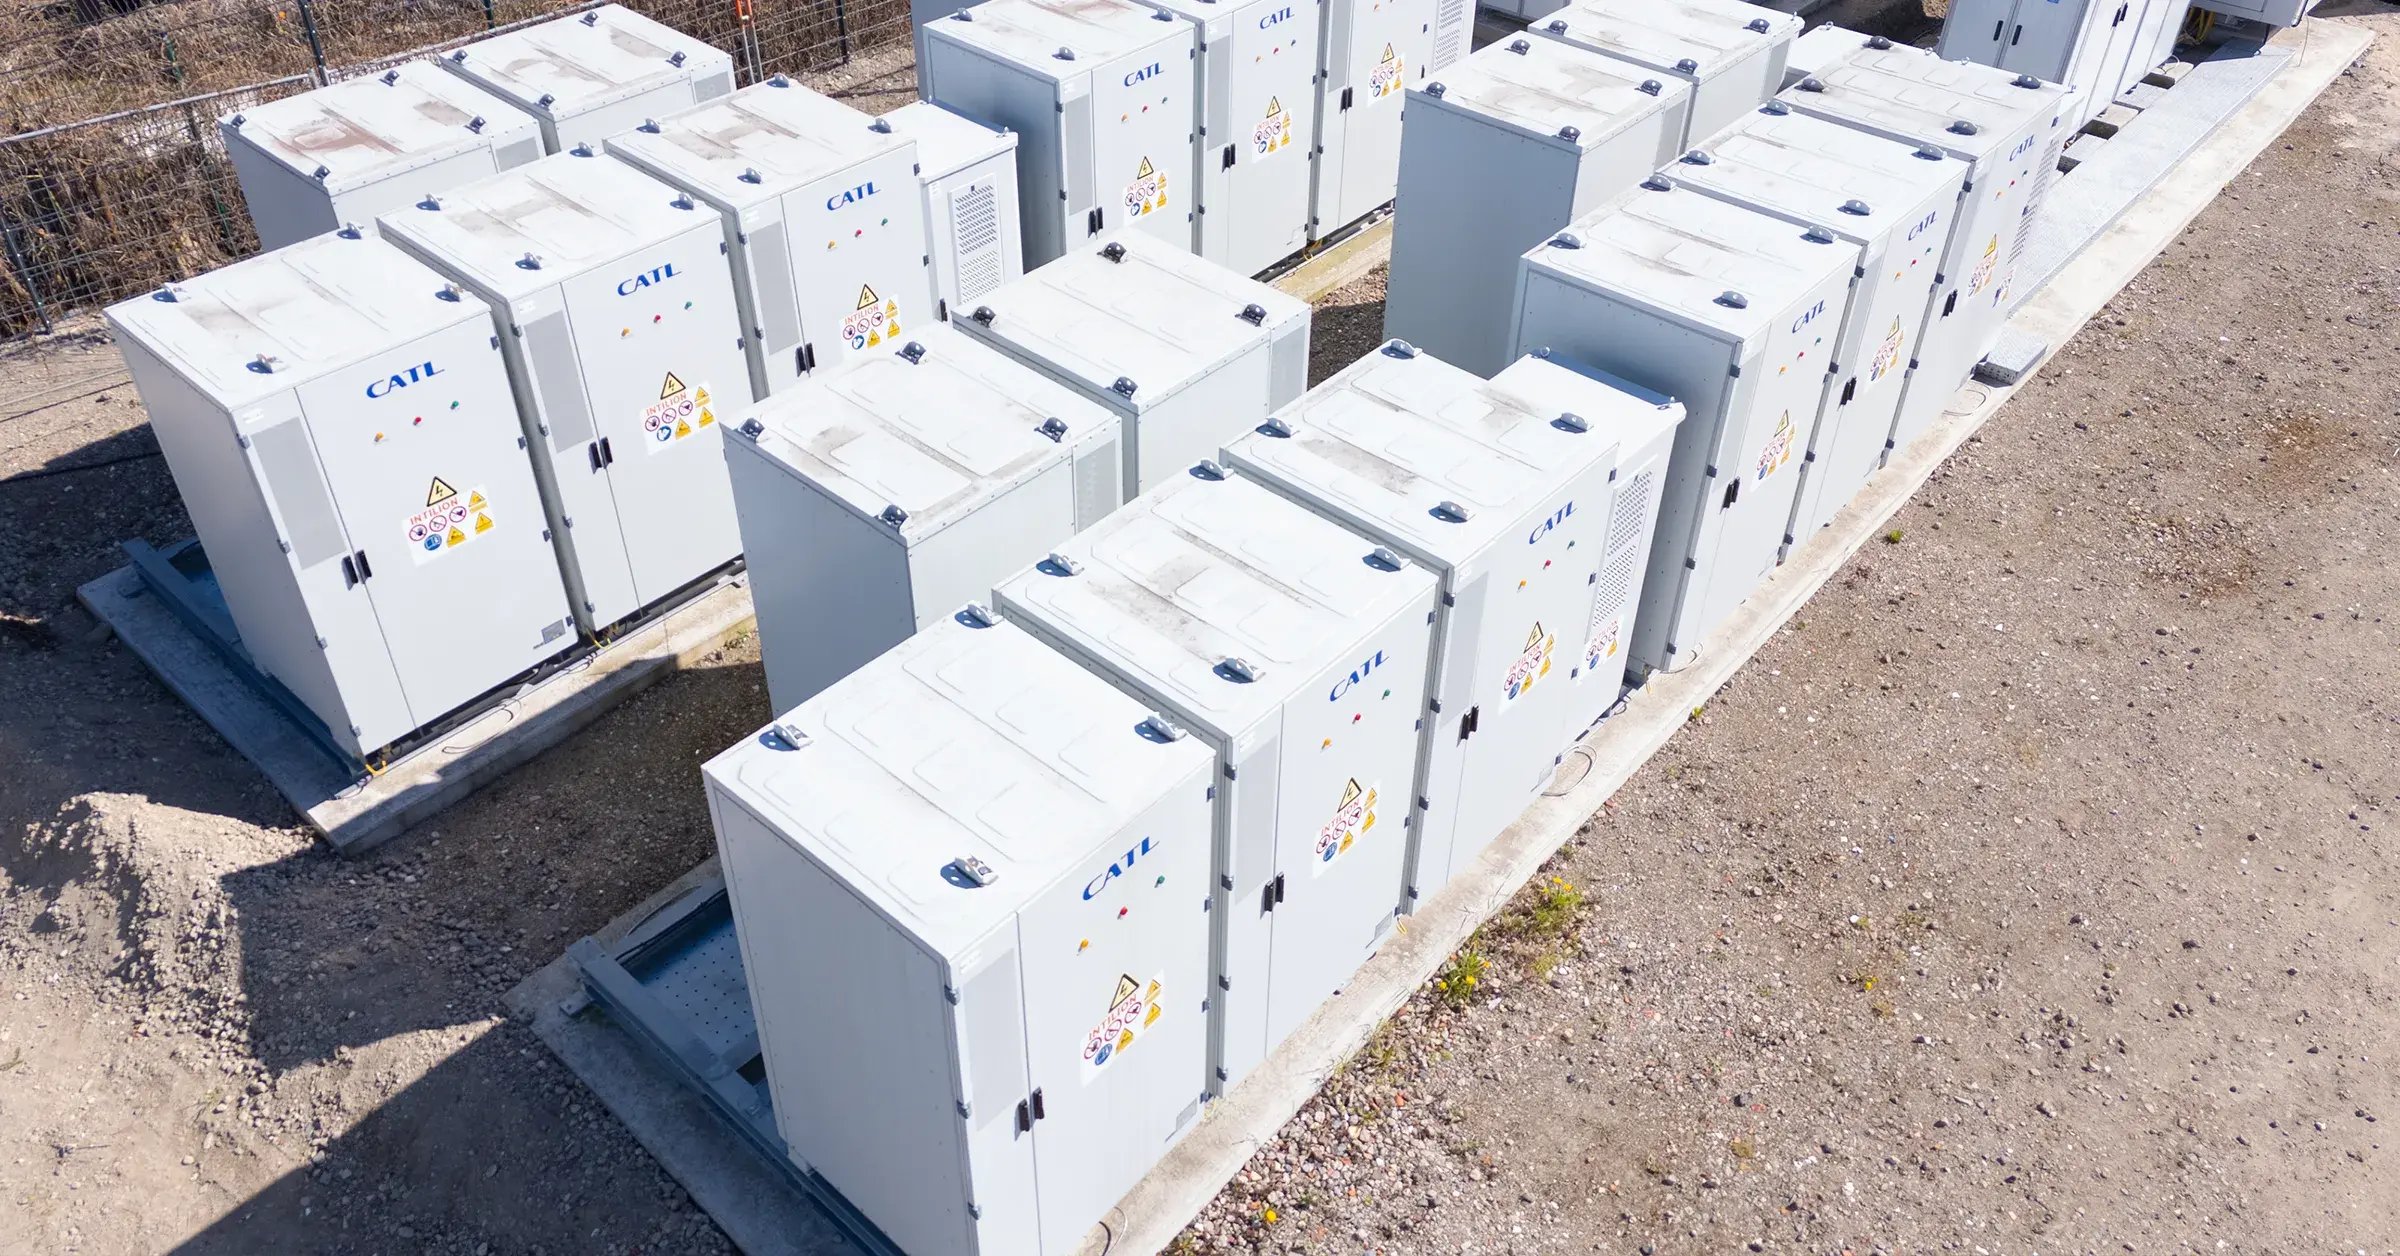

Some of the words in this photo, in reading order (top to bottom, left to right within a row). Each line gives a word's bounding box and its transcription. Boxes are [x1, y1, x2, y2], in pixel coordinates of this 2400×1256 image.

[1260, 7, 1295, 29] CATL
[1124, 63, 1164, 87] CATL
[2009, 134, 2036, 161] CATL
[827, 182, 881, 211] CATL
[1908, 211, 1936, 241] CATL
[617, 263, 682, 296] CATL
[845, 303, 879, 325] INTILION
[1792, 299, 1826, 333] CATL
[366, 361, 445, 398] CATL
[646, 391, 687, 416] INTILION
[410, 497, 458, 525] INTILION
[1529, 501, 1577, 544] CATL
[1330, 650, 1389, 701] CATL
[1321, 798, 1359, 836] INTILION
[1083, 837, 1160, 900] CATL
[1089, 993, 1136, 1040] INTILION
